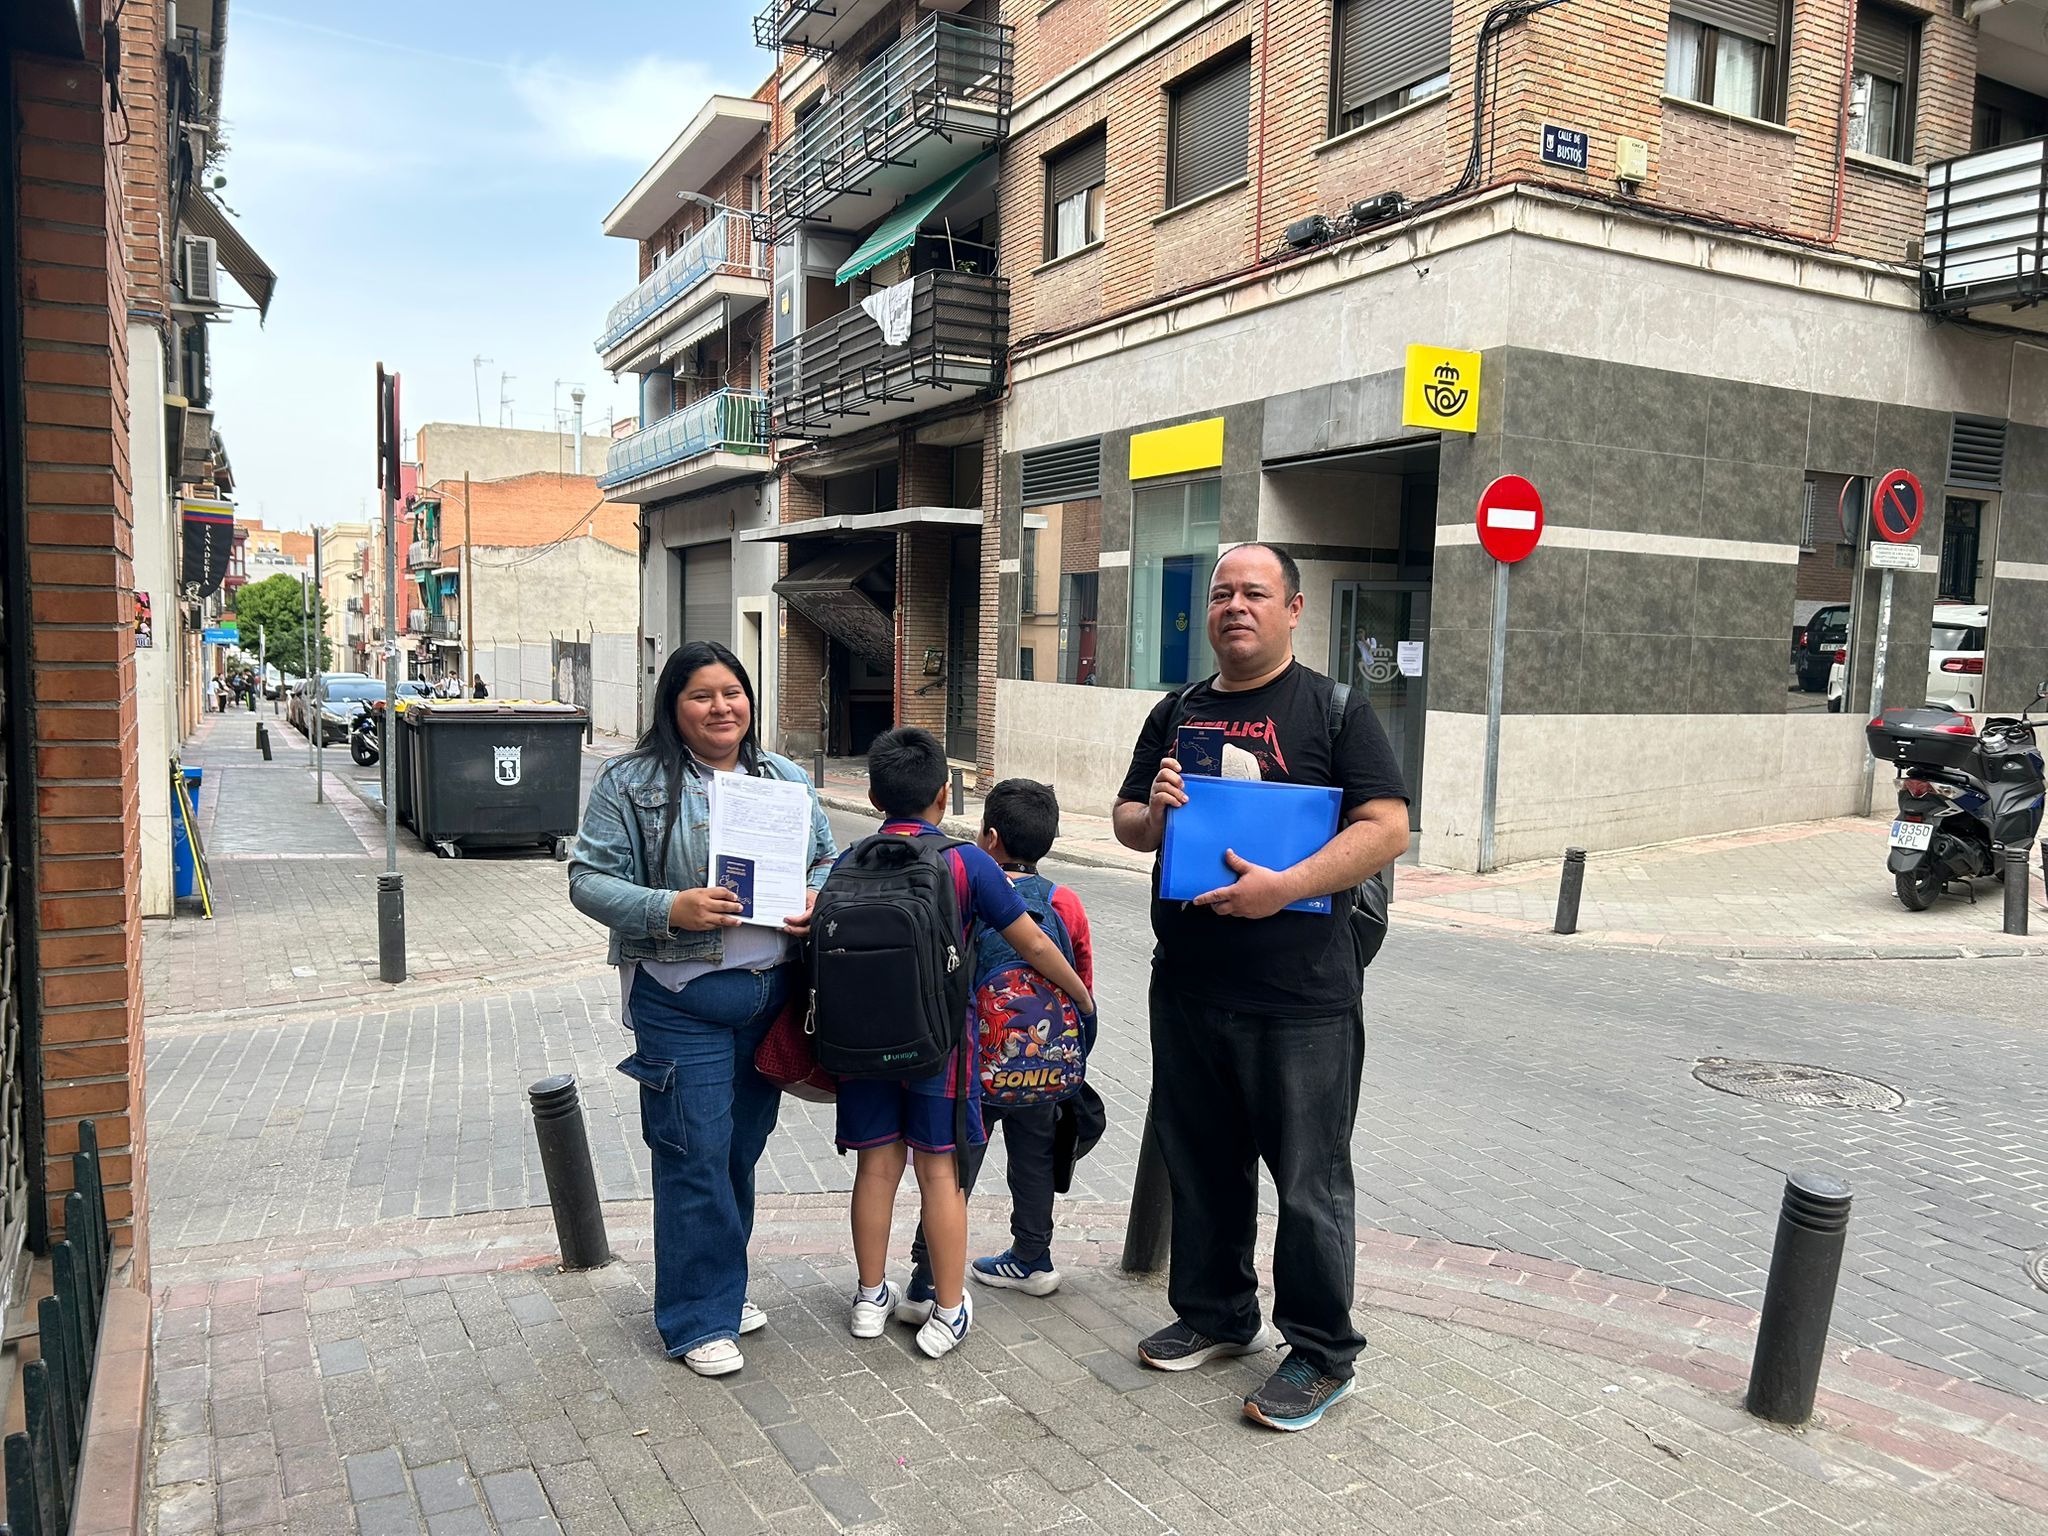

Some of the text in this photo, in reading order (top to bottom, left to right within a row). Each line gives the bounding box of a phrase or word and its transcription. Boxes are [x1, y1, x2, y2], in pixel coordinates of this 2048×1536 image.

[1557, 130, 1581, 145] CALLE DE
[1556, 144, 1582, 163] BUSTOS
[1900, 822, 1930, 837] 9350
[1897, 834, 1919, 847] KPL
[993, 1068, 1063, 1088] SONIC
